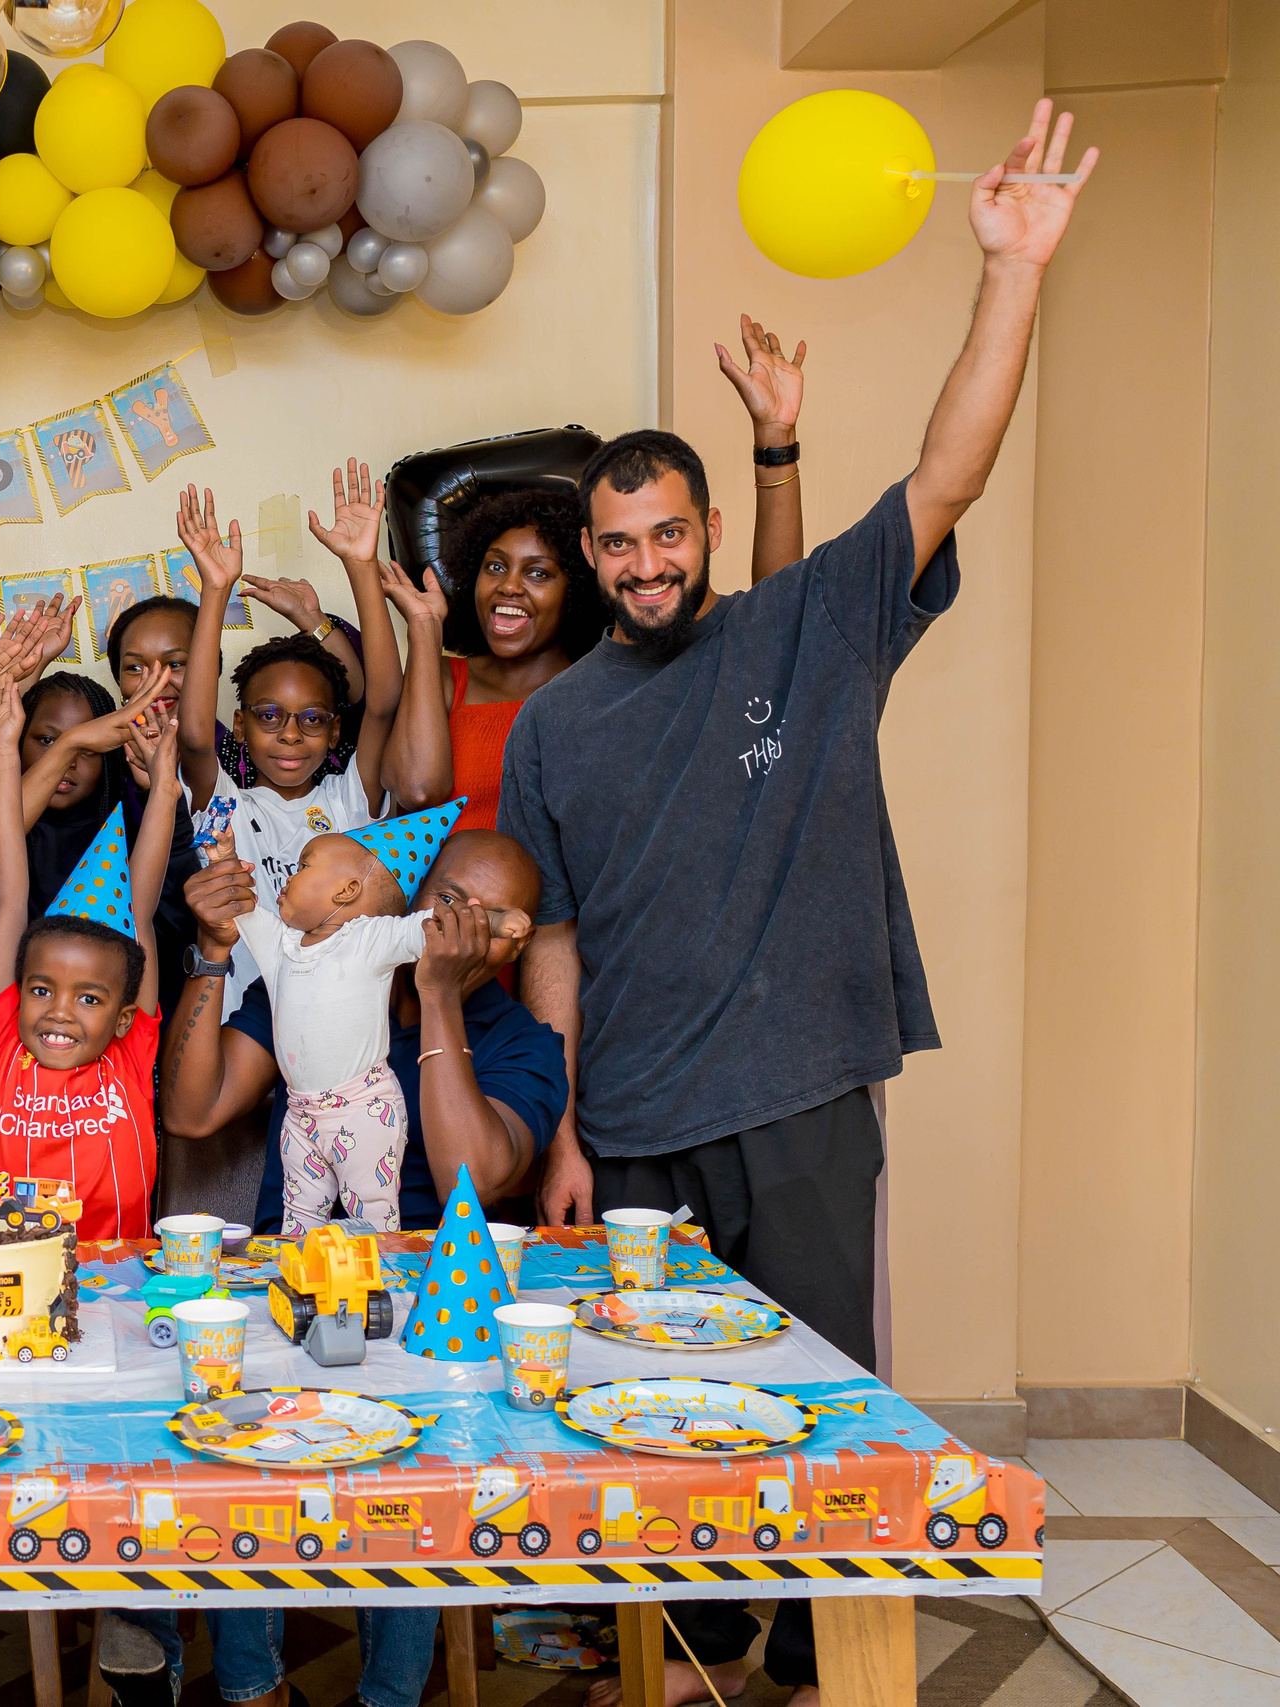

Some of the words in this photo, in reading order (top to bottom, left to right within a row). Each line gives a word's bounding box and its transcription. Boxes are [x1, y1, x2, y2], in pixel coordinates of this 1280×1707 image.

[14, 1083, 109, 1115] Standard
[609, 1242, 655, 1257] HDAY
[5, 1296, 12, 1307] 5
[185, 1340, 244, 1357] BIRTHD
[507, 1345, 570, 1361] BIRTHD
[618, 1390, 707, 1407] HAPPY
[590, 1399, 747, 1416] BIRTHDAY
[825, 1494, 866, 1505] UNDER
[367, 1504, 410, 1516] UNDER
